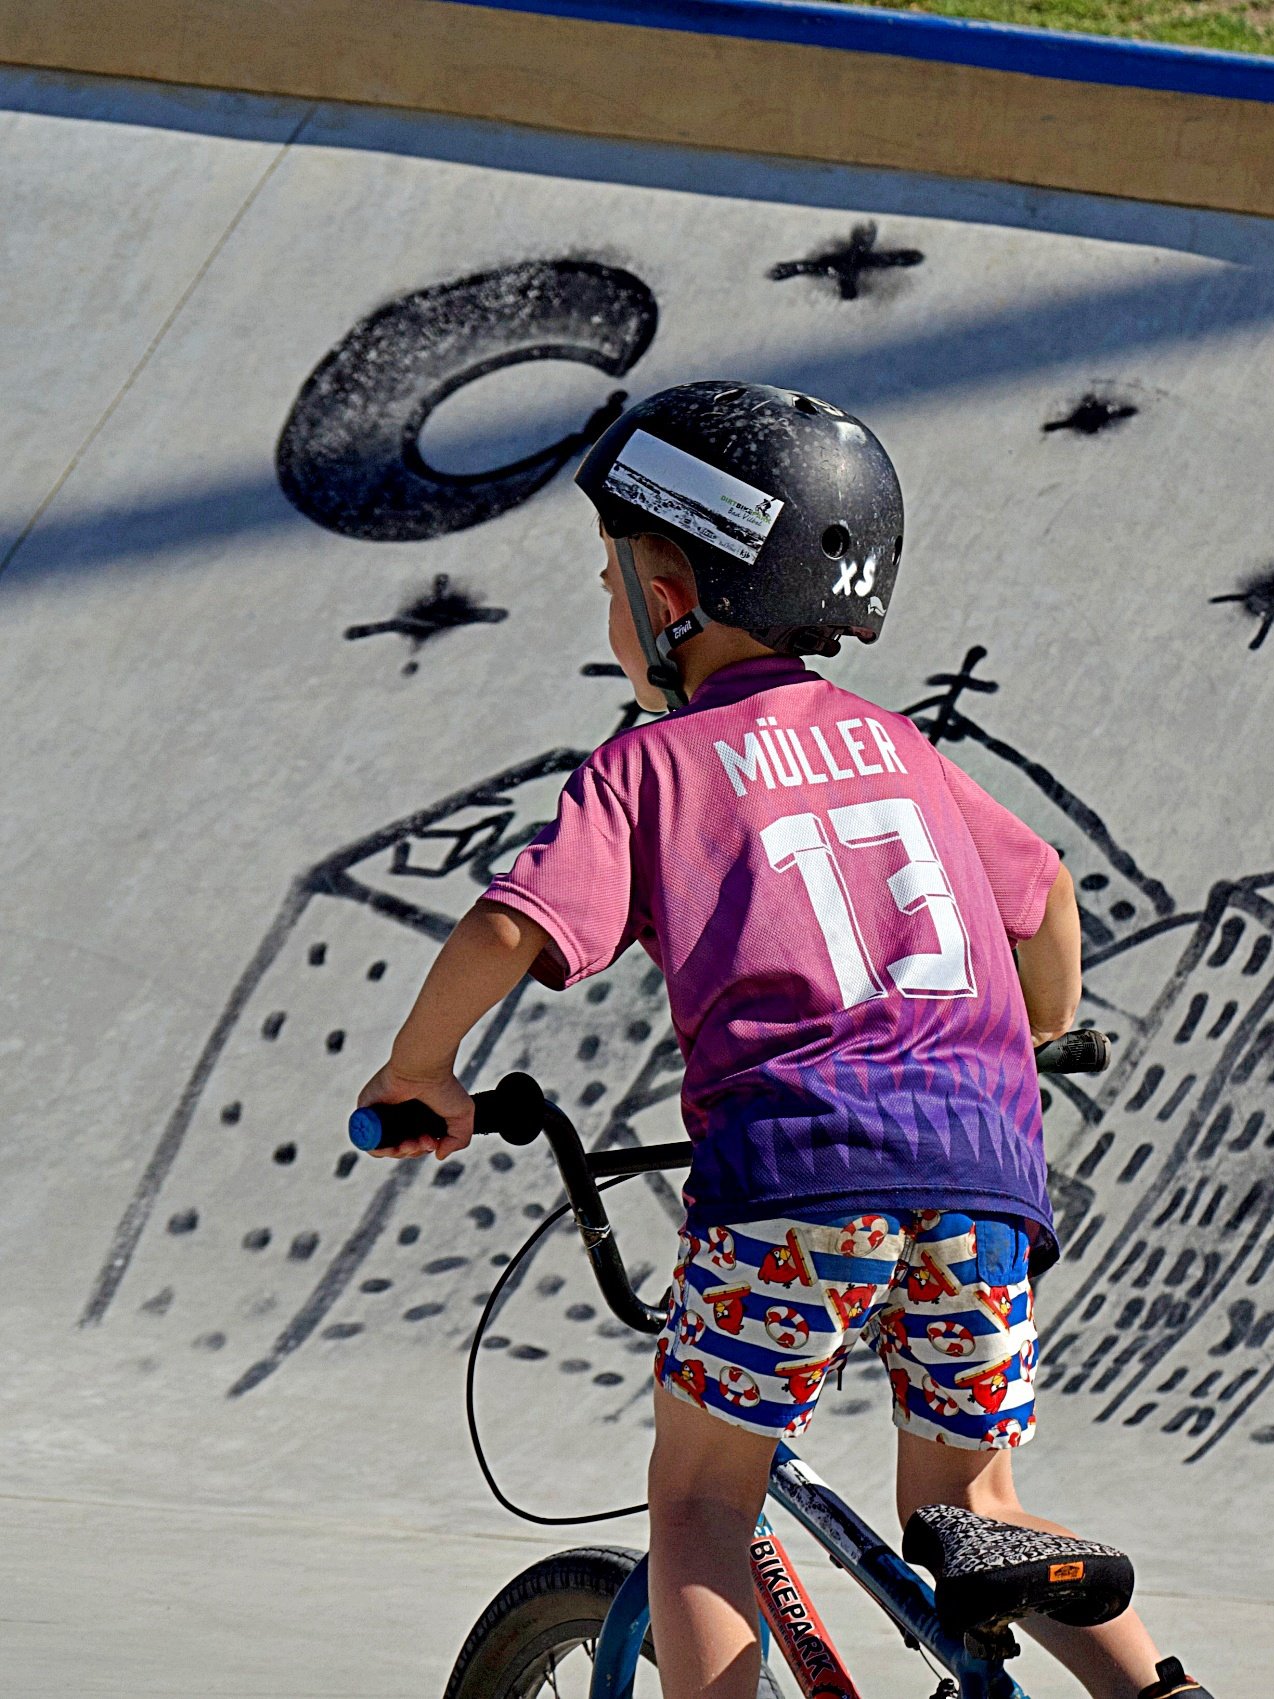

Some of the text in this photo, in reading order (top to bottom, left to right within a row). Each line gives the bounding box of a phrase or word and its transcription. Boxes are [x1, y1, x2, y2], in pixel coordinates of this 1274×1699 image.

[832, 557, 876, 597] XS
[713, 717, 908, 797] MÜLLER
[760, 798, 978, 1008] 13
[750, 1538, 837, 1682] BIKEPARK
